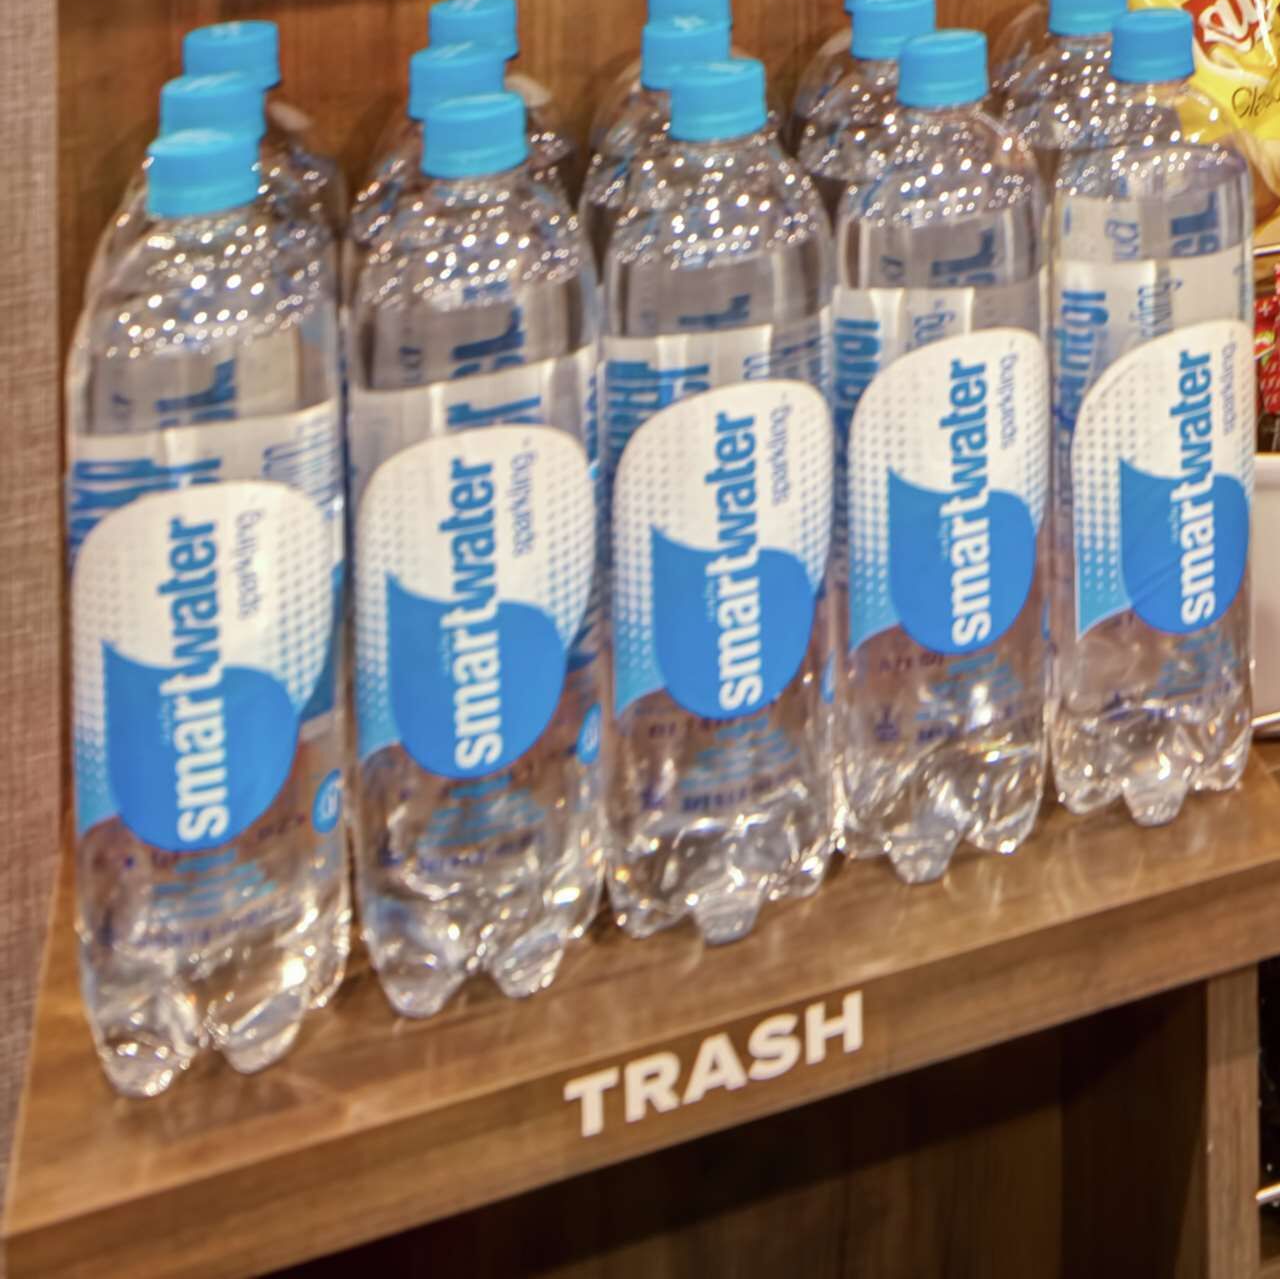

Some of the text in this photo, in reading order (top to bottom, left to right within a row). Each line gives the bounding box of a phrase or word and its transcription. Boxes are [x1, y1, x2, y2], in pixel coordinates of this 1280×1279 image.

[439, 456, 501, 771] smartwater
[705, 411, 763, 710] smartwater
[938, 358, 990, 647] smartwater
[1168, 349, 1216, 626] smartwater
[159, 516, 228, 842] smartwater
[563, 990, 864, 1138] TRASH
